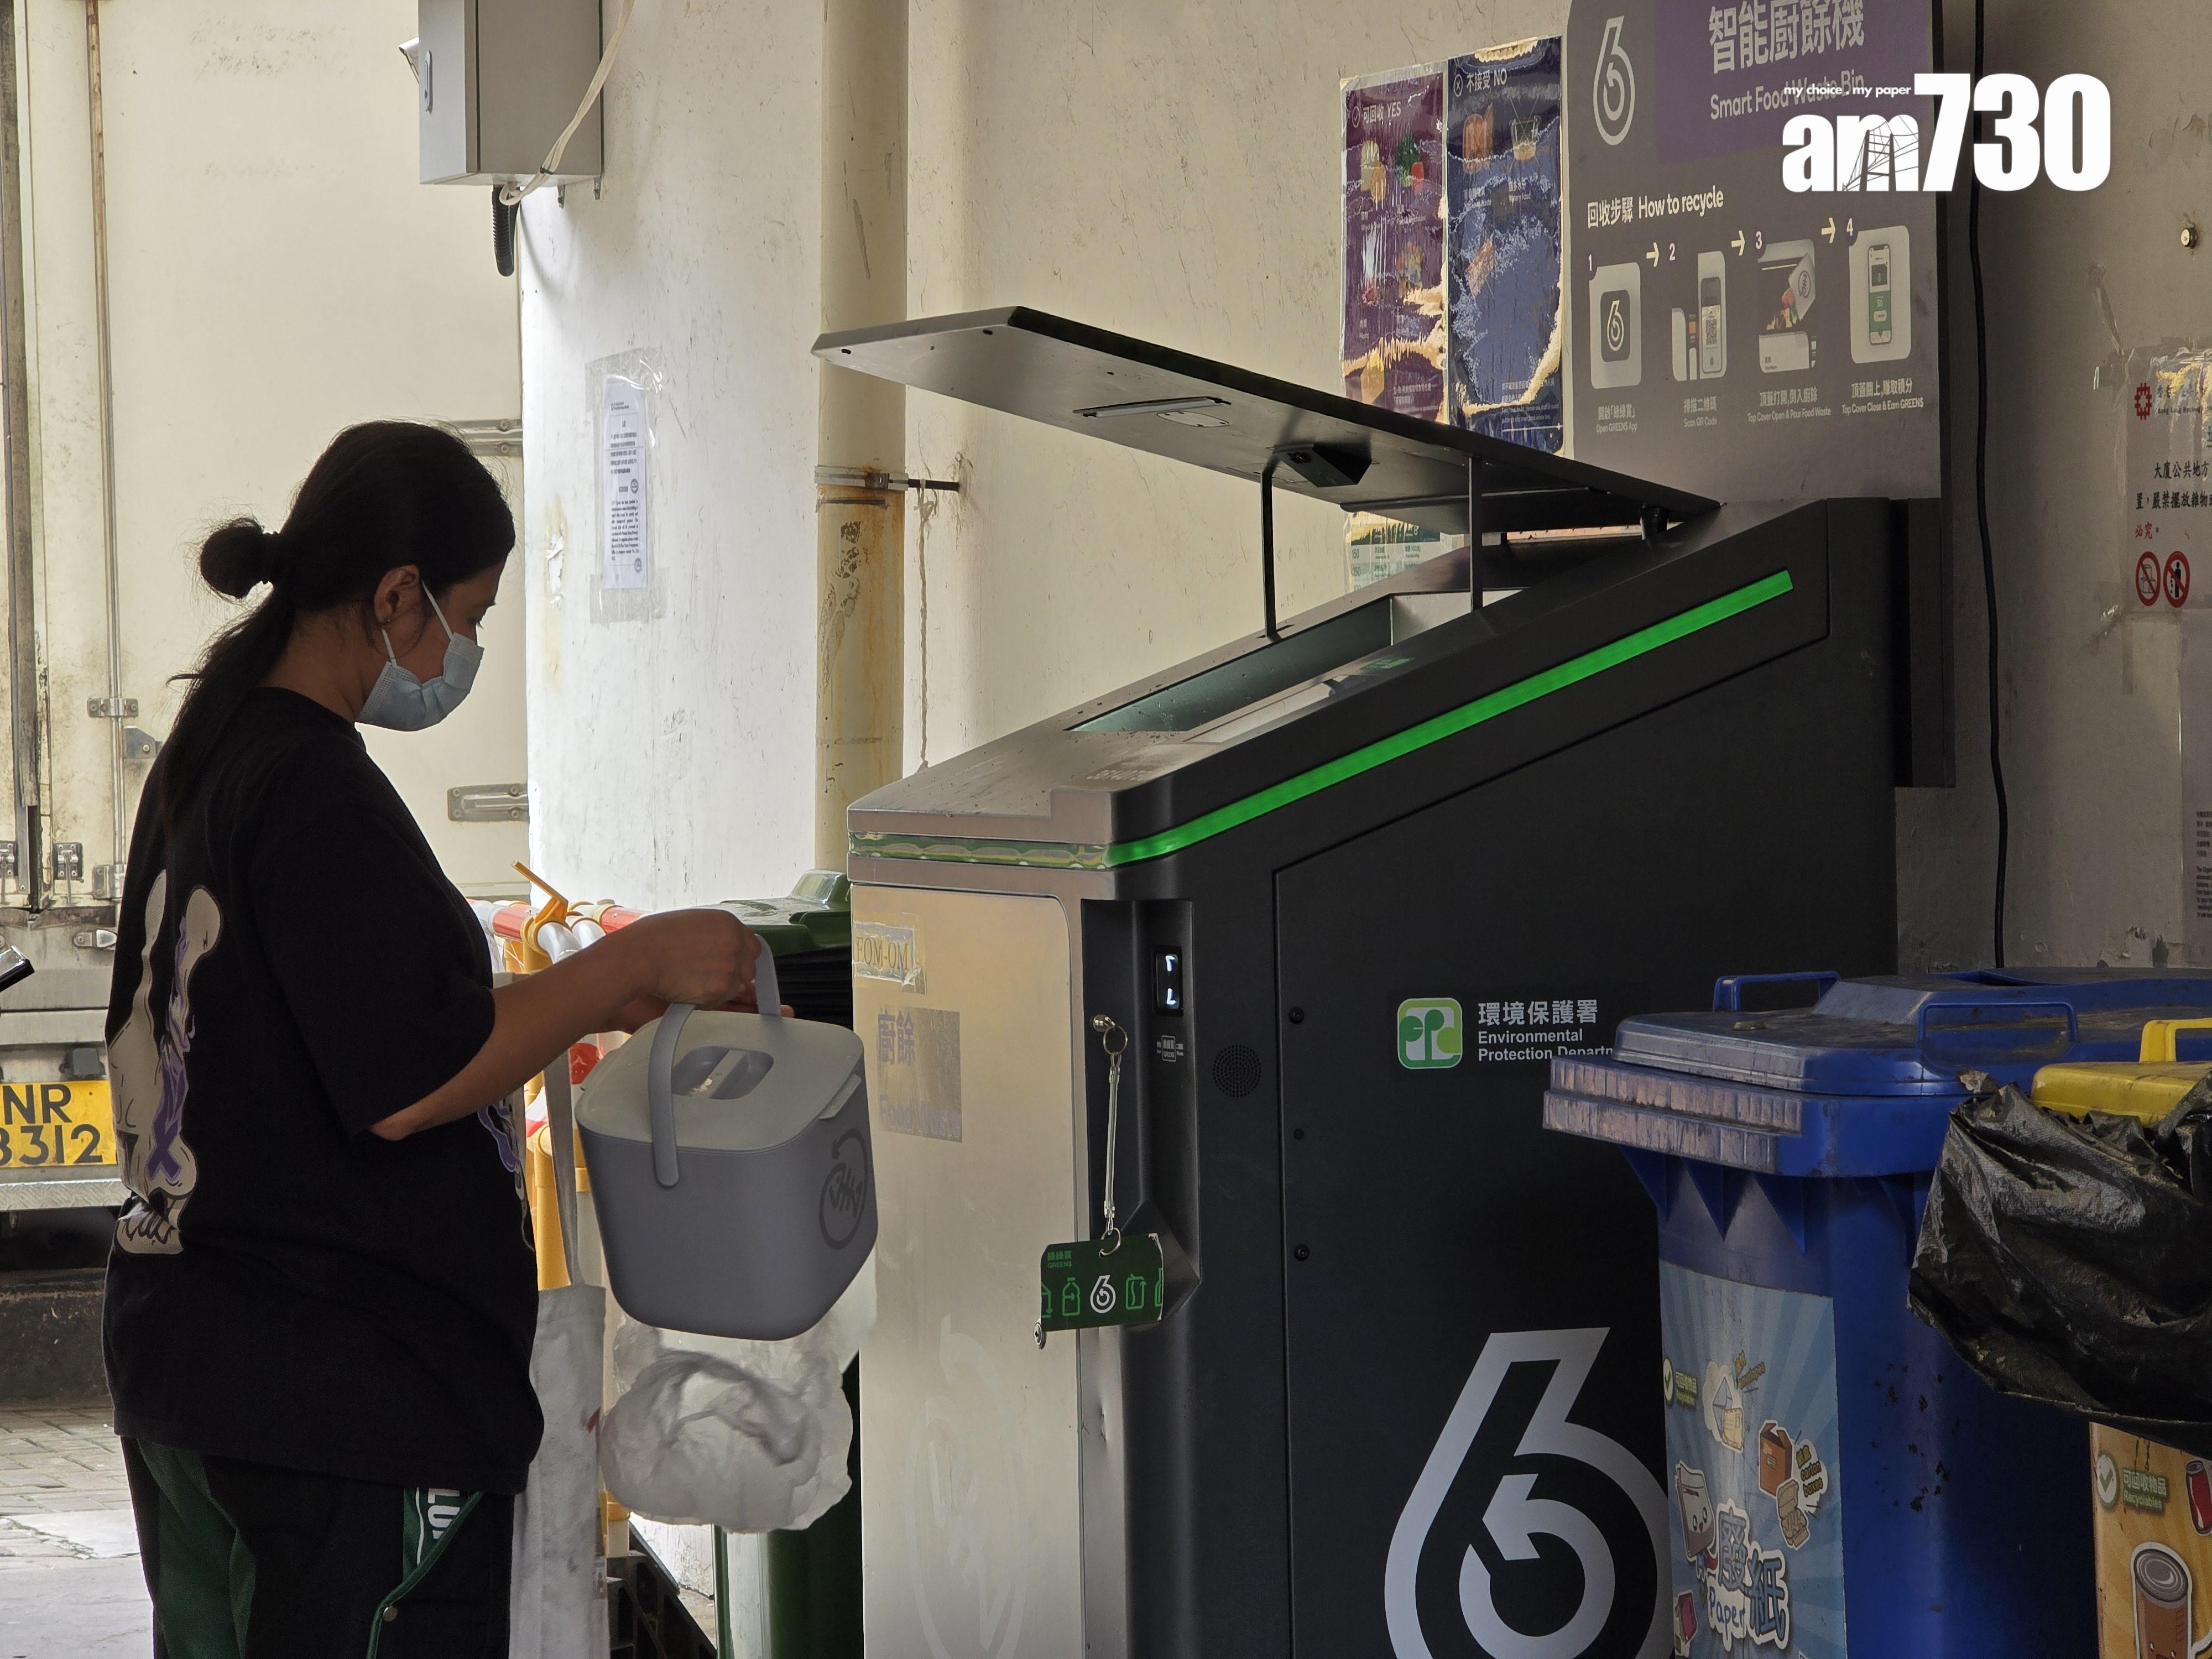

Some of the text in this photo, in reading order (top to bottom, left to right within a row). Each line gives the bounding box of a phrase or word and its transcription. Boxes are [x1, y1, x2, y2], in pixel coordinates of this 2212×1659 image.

[1709, 0, 1864, 74] 智能廚餘機
[1467, 67, 1507, 93] 不接受 NO
[1710, 90, 1752, 119] Smart
[1755, 81, 1789, 112] Food
[1841, 69, 1864, 97] Bin
[1363, 101, 1401, 124] 可回收 YES
[1588, 185, 1724, 228] 回收步驟 How to recycle
[1846, 218, 1853, 236] 4
[1756, 231, 1762, 249] 3
[1669, 243, 1676, 261] 2
[1588, 254, 1592, 272] 1
[1747, 406, 1832, 424] Top Cover Open & Pour Food Waste
[1841, 404, 1851, 416] Top
[1851, 403, 1867, 414] Cover
[1867, 401, 1881, 412] Close
[1882, 400, 1887, 410] &
[1887, 399, 1900, 410] Earn
[1596, 424, 1609, 434] Open
[1629, 422, 1638, 432] App
[1684, 416, 1717, 427] Scan QR Code
[2154, 461, 2210, 479] 大廈公共地方
[1478, 999, 1598, 1027] 環境保護署
[878, 1010, 915, 1067] 廚餘
[1478, 1028, 1583, 1045] Environmental
[1478, 1047, 1553, 1062] Protection
[2, 1083, 72, 1125] NR
[1801, 1460, 1822, 1482] carton
[1803, 1477, 1823, 1498] boxes
[2124, 1489, 2162, 1509] Recyclables
[1709, 1585, 1746, 1641] Paper
